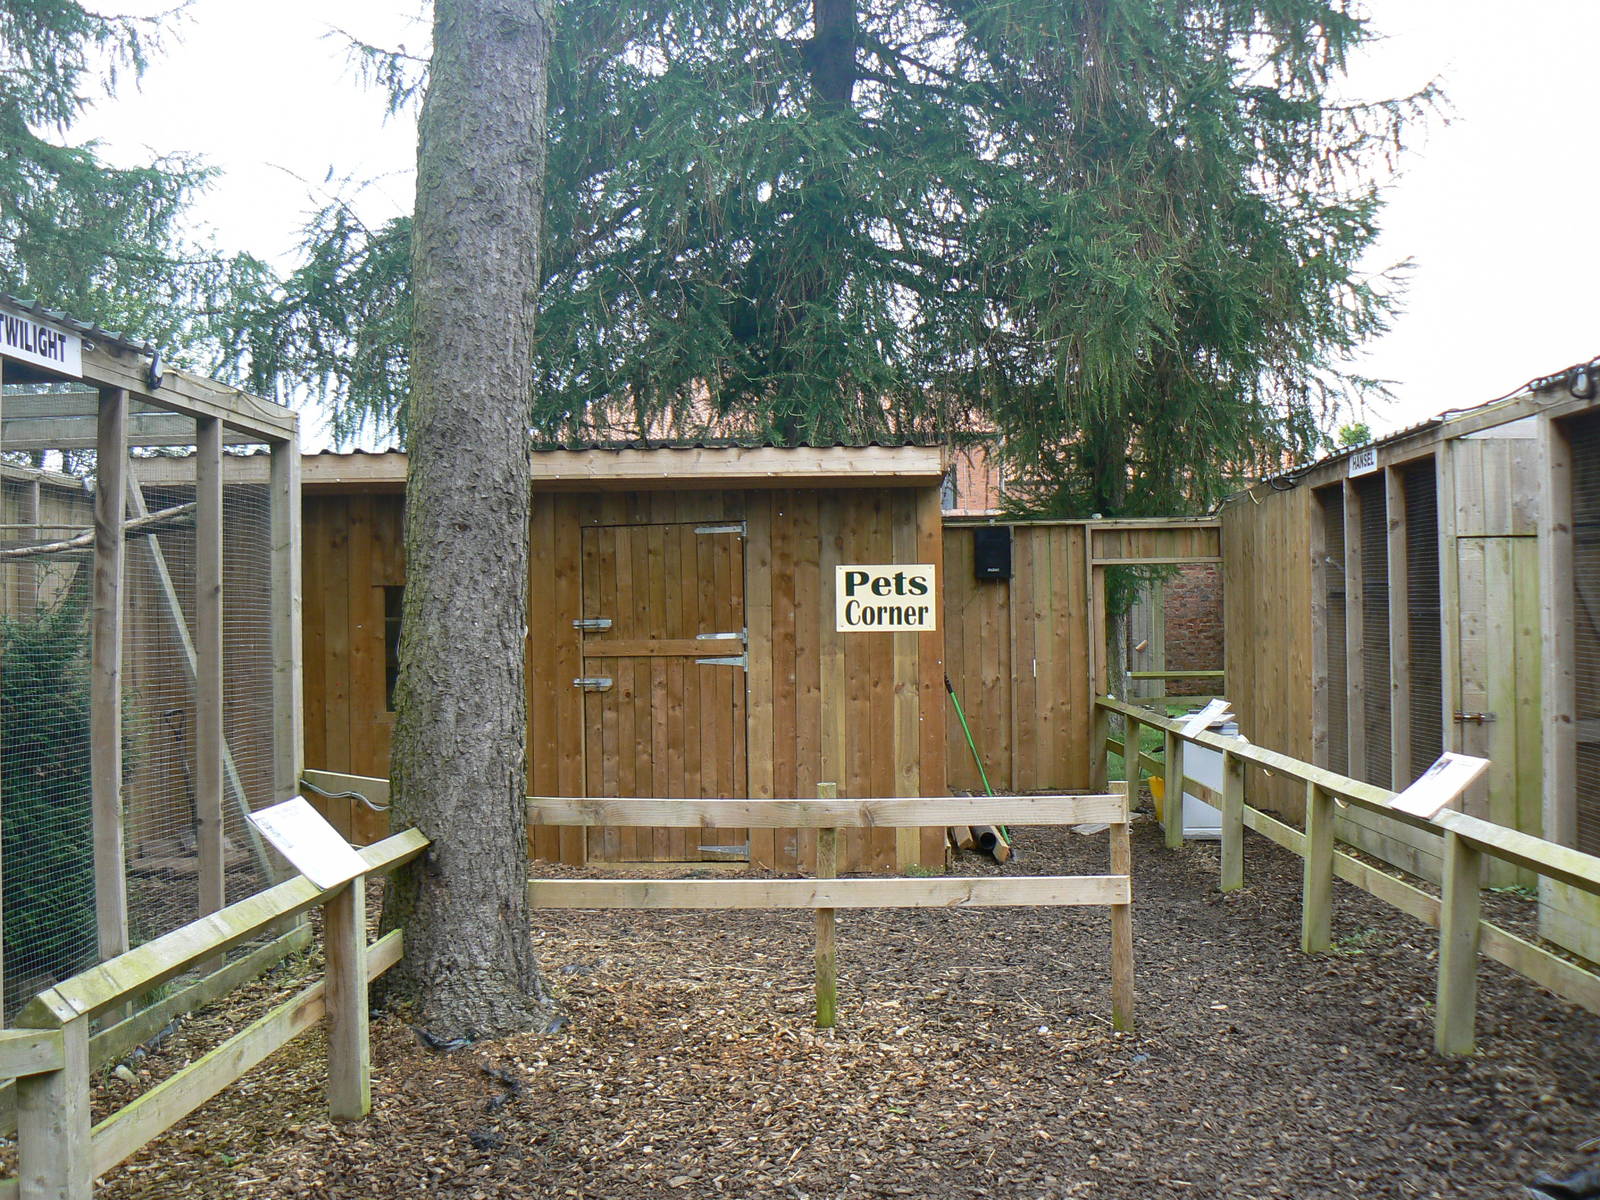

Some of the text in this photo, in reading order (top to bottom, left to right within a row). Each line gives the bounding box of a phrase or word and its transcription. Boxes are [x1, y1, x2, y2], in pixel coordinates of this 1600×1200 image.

[1353, 452, 1374, 470] HANSEL
[845, 571, 928, 596] Pets
[845, 599, 929, 625] Corner
